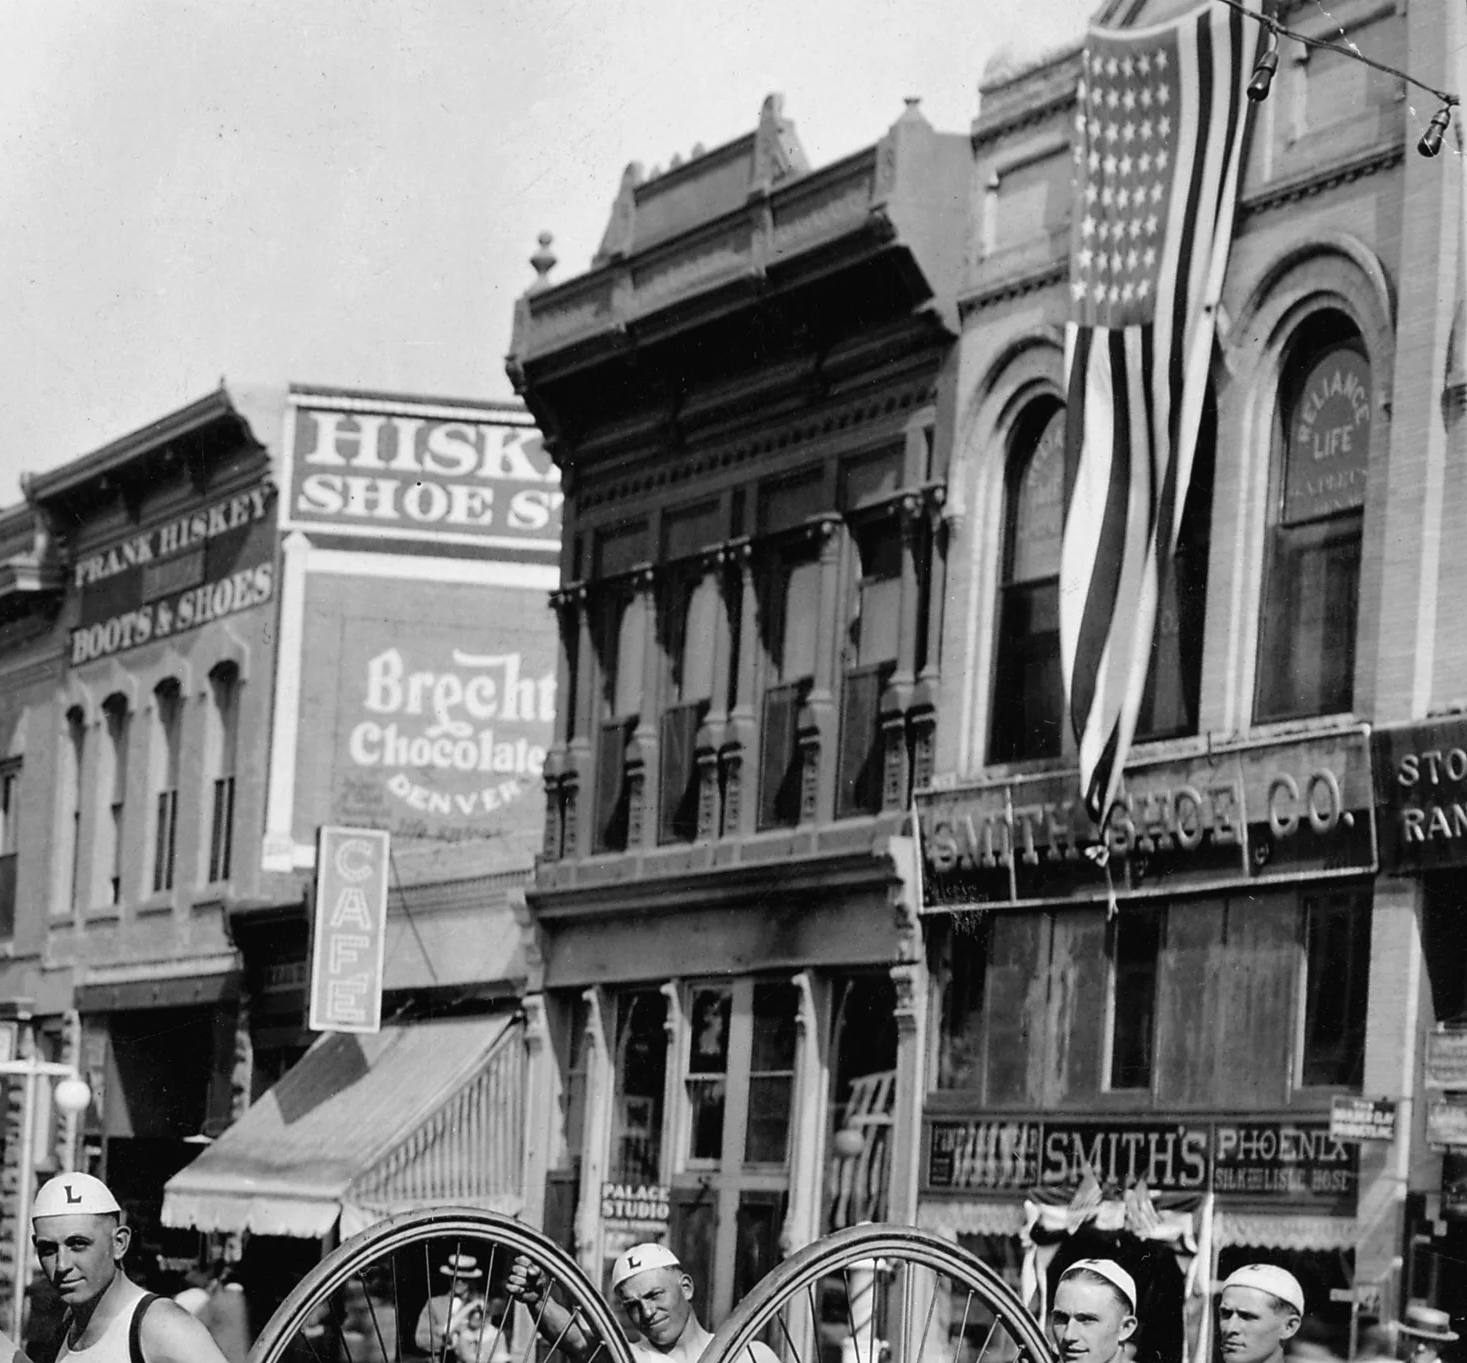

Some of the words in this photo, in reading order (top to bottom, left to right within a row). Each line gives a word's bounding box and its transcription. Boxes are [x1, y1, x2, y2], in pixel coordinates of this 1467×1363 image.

[305, 411, 561, 483] HISK
[1314, 424, 1353, 459] LIFE
[297, 473, 494, 526] SHOE
[75, 532, 153, 588] FRANK
[72, 605, 153, 665] BOOTS
[154, 601, 172, 637] &
[176, 562, 272, 630] SHOES
[363, 647, 558, 738] Brecht
[387, 773, 521, 816] DENVER
[924, 799, 1081, 873] SMITH
[1110, 784, 1244, 855] SHOE
[1268, 767, 1355, 840] CO.
[1043, 1124, 1208, 1187] SMITH'S
[1216, 1168, 1246, 1189] SILK
[64, 1185, 83, 1204] L
[602, 1184, 670, 1201] PALACE
[602, 1200, 670, 1219] STUDIO
[627, 1256, 642, 1269] L
